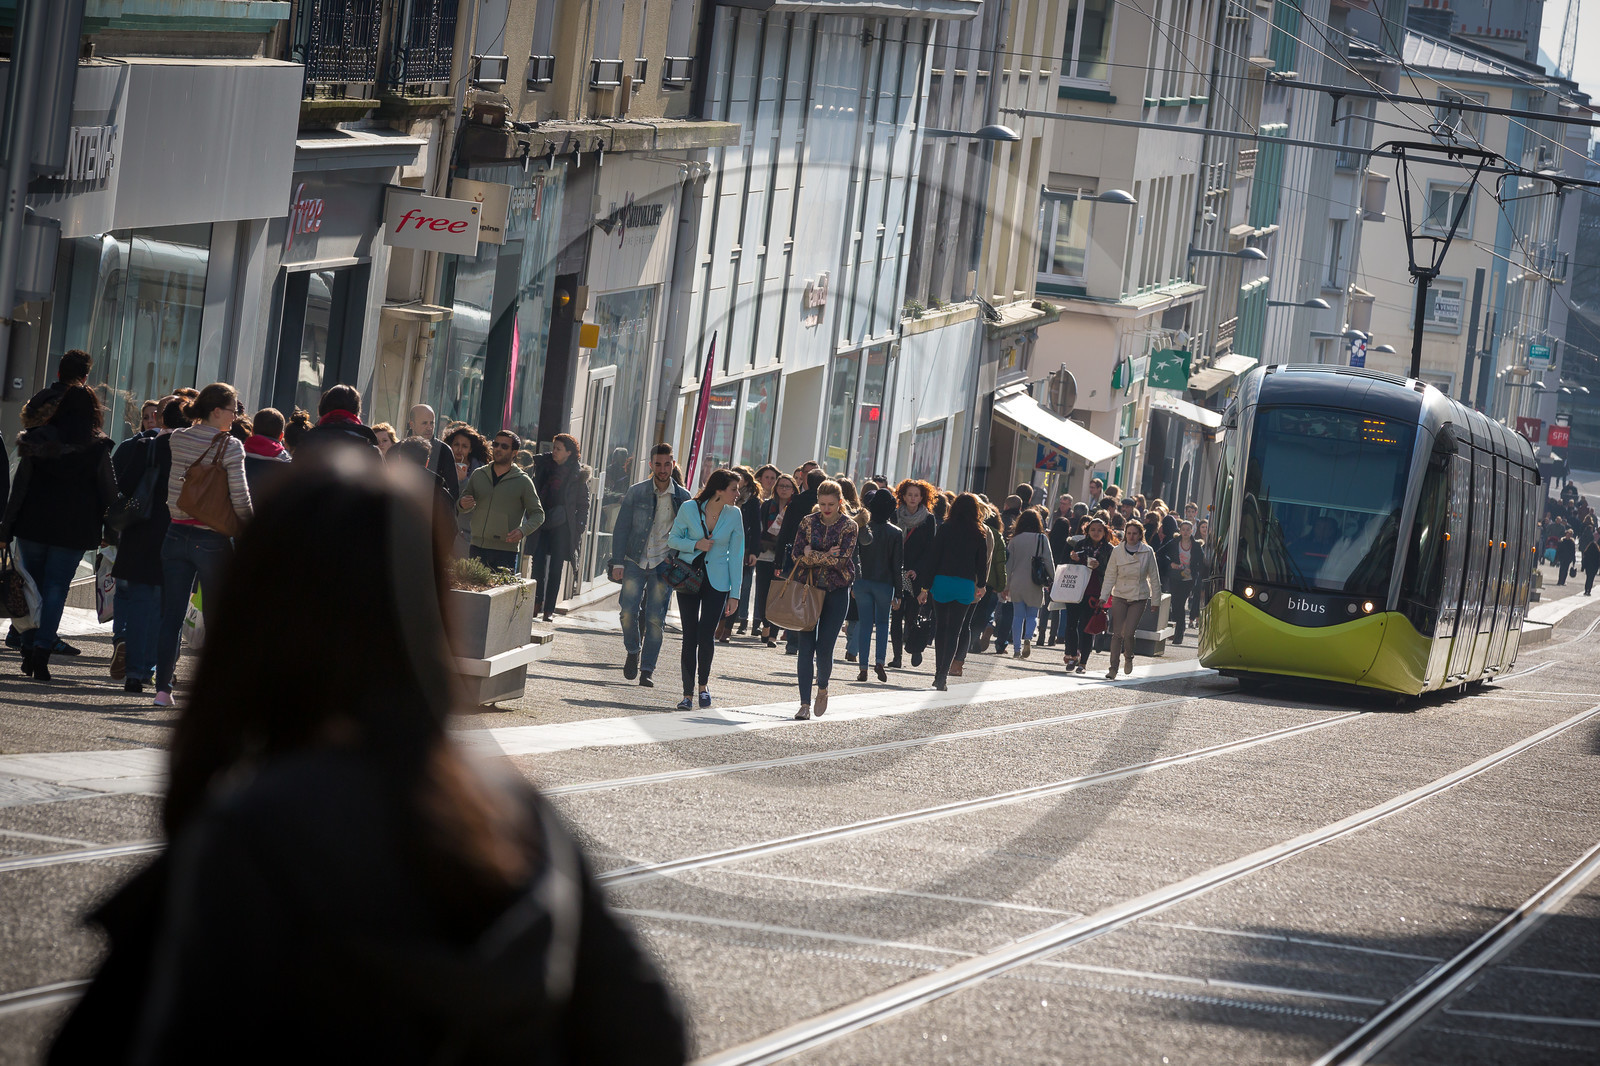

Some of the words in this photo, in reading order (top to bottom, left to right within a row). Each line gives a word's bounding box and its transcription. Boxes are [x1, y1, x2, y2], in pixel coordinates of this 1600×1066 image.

[286, 183, 325, 252] free
[394, 208, 469, 234] free
[479, 223, 500, 233] pine
[1552, 431, 1569, 441] SFR
[1288, 597, 1326, 613] bibus
